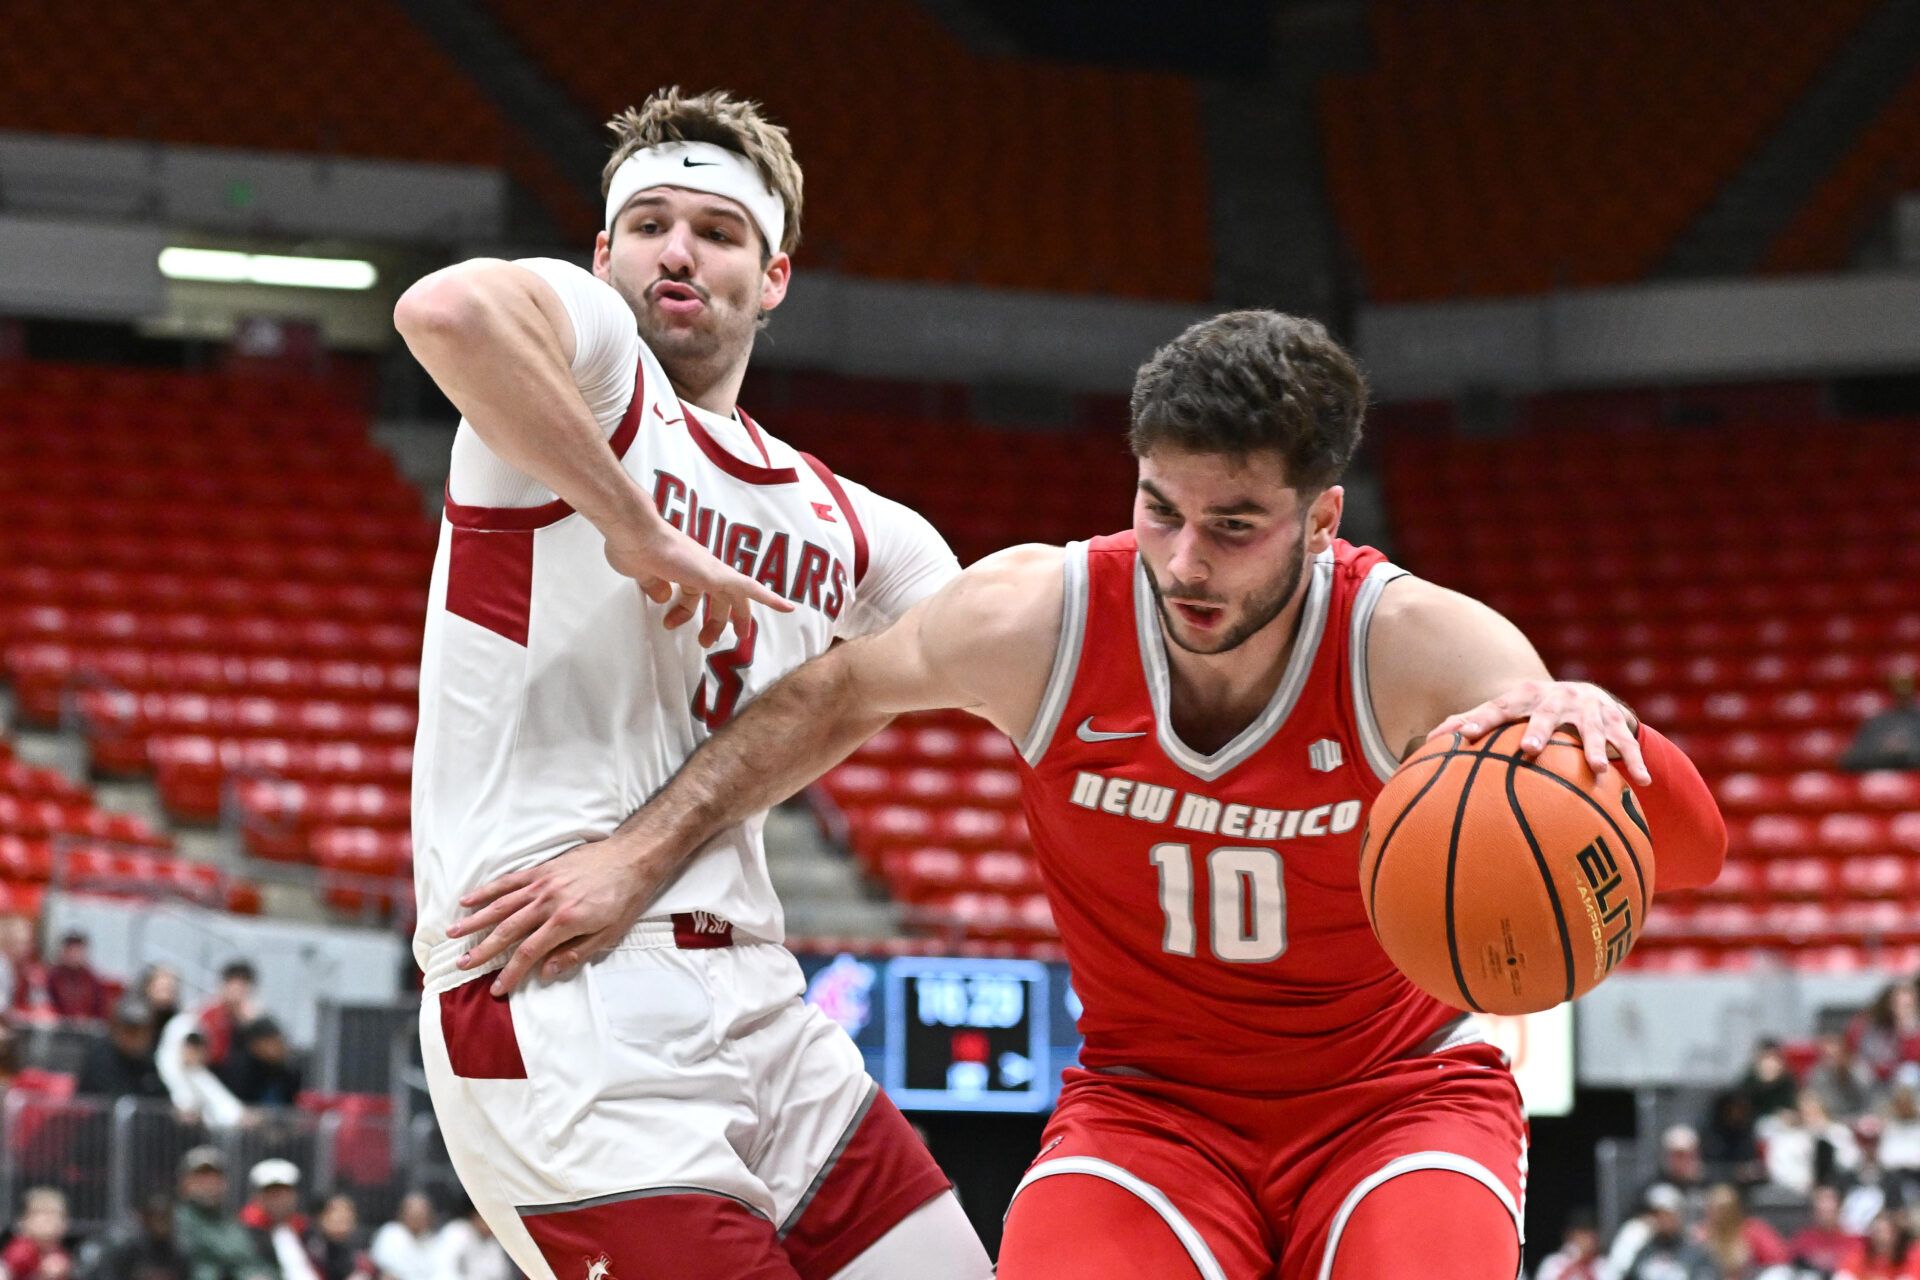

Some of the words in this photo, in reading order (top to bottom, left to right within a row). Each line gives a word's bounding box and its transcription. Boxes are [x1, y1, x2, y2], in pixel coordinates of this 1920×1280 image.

[653, 468, 848, 622] CUGARS
[1069, 770, 1177, 824] NEW
[1173, 792, 1362, 840] MEXICO
[691, 911, 729, 934] WSU
[1149, 842, 1288, 964] 10
[1576, 835, 1632, 974] ELITE
